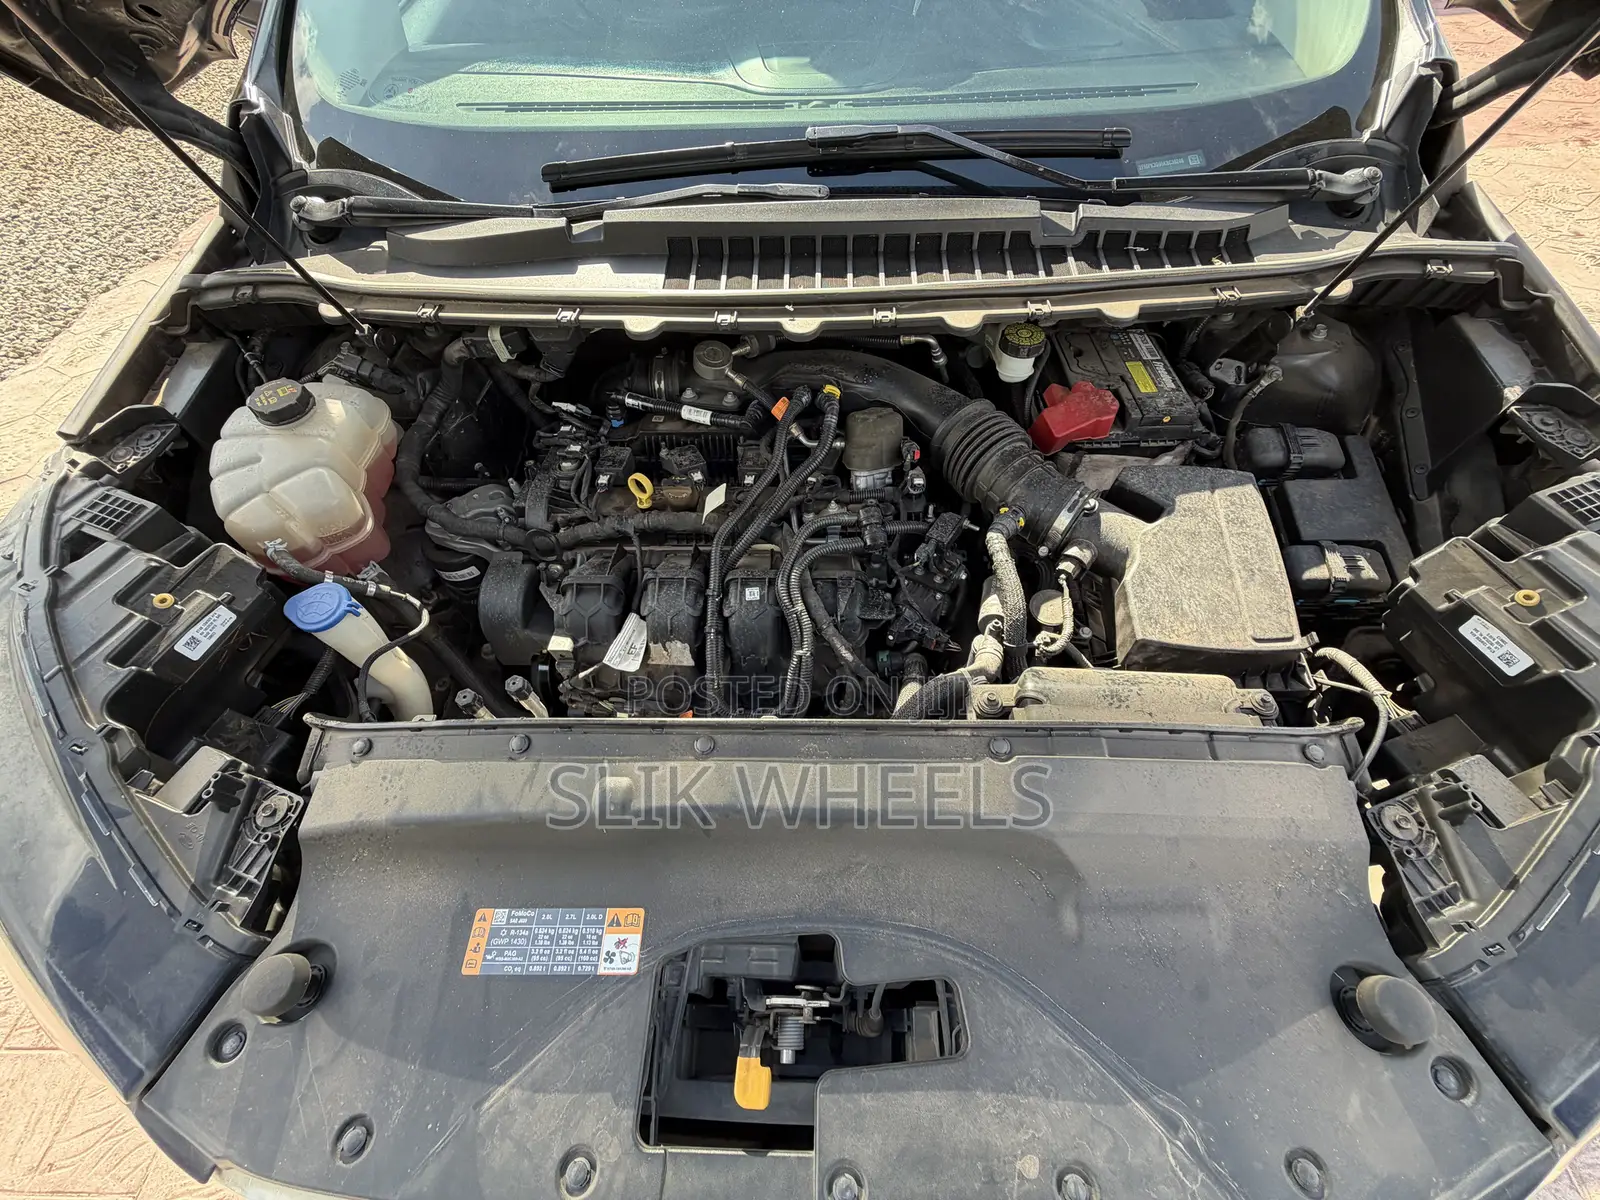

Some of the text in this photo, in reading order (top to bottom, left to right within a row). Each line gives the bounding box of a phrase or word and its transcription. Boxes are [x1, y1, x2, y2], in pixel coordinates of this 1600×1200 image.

[627, 642, 638, 655] EF
[490, 938, 527, 946] (GWP 1430)
